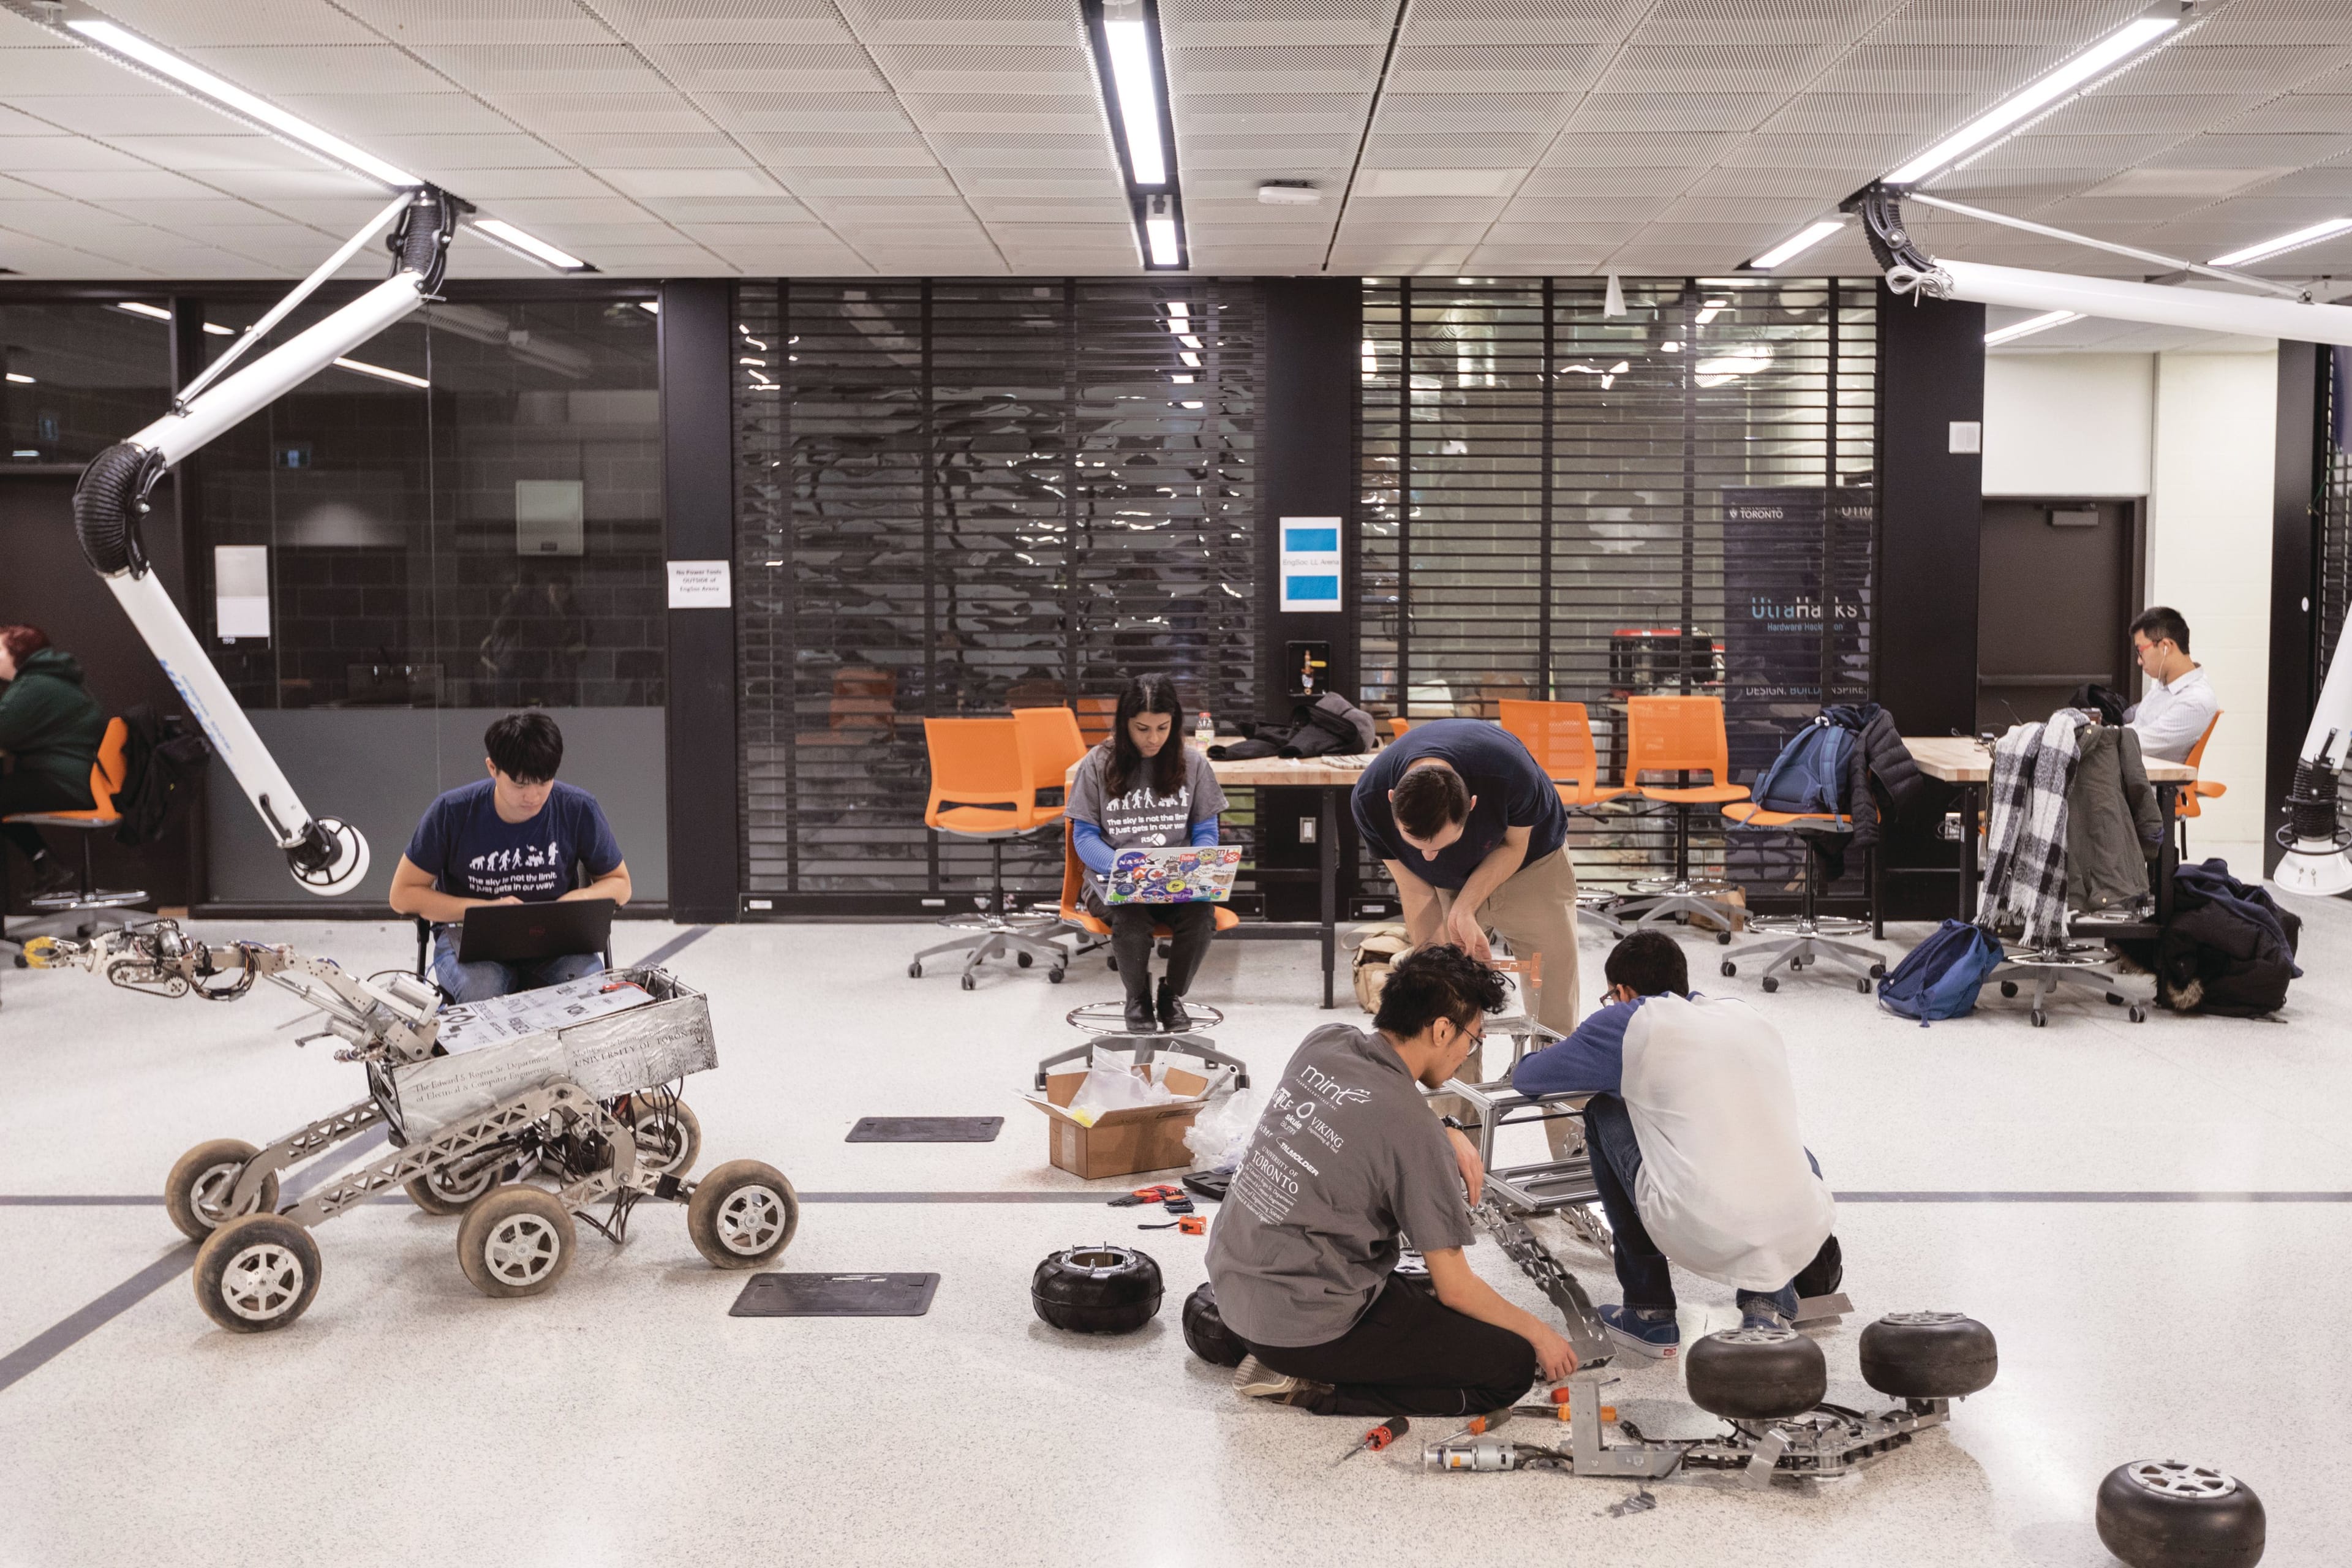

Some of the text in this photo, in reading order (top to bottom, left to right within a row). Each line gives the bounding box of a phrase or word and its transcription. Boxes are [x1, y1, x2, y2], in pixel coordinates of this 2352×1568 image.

[1740, 510, 1783, 519] TORONTO
[1767, 622, 1803, 631] Hardware
[1115, 826, 1131, 835] just
[468, 875, 484, 885] The
[526, 873, 537, 882] the
[476, 884, 492, 894] just
[494, 884, 512, 894] gets
[575, 1045, 637, 1067] UNIVERSITY
[657, 1027, 701, 1045] TORONTO
[415, 1084, 429, 1093] The
[431, 1074, 459, 1090] Edward
[469, 1068, 493, 1080] Rogers
[507, 1056, 549, 1071] Department
[426, 1085, 461, 1100] Electrical
[471, 1076, 507, 1089] Computer
[509, 1066, 551, 1081] Engineering
[1300, 1065, 1351, 1106] mint
[1285, 1114, 1302, 1129] skule
[1311, 1117, 1344, 1148] VIKING
[1262, 1145, 1289, 1170] UNIVERSITY
[1330, 1144, 1339, 1154] Tool
[1252, 1150, 1298, 1194] TORONTO
[1268, 1194, 1290, 1213] Engineering
[1273, 1189, 1294, 1207] Department
[1269, 1208, 1284, 1222] Science
